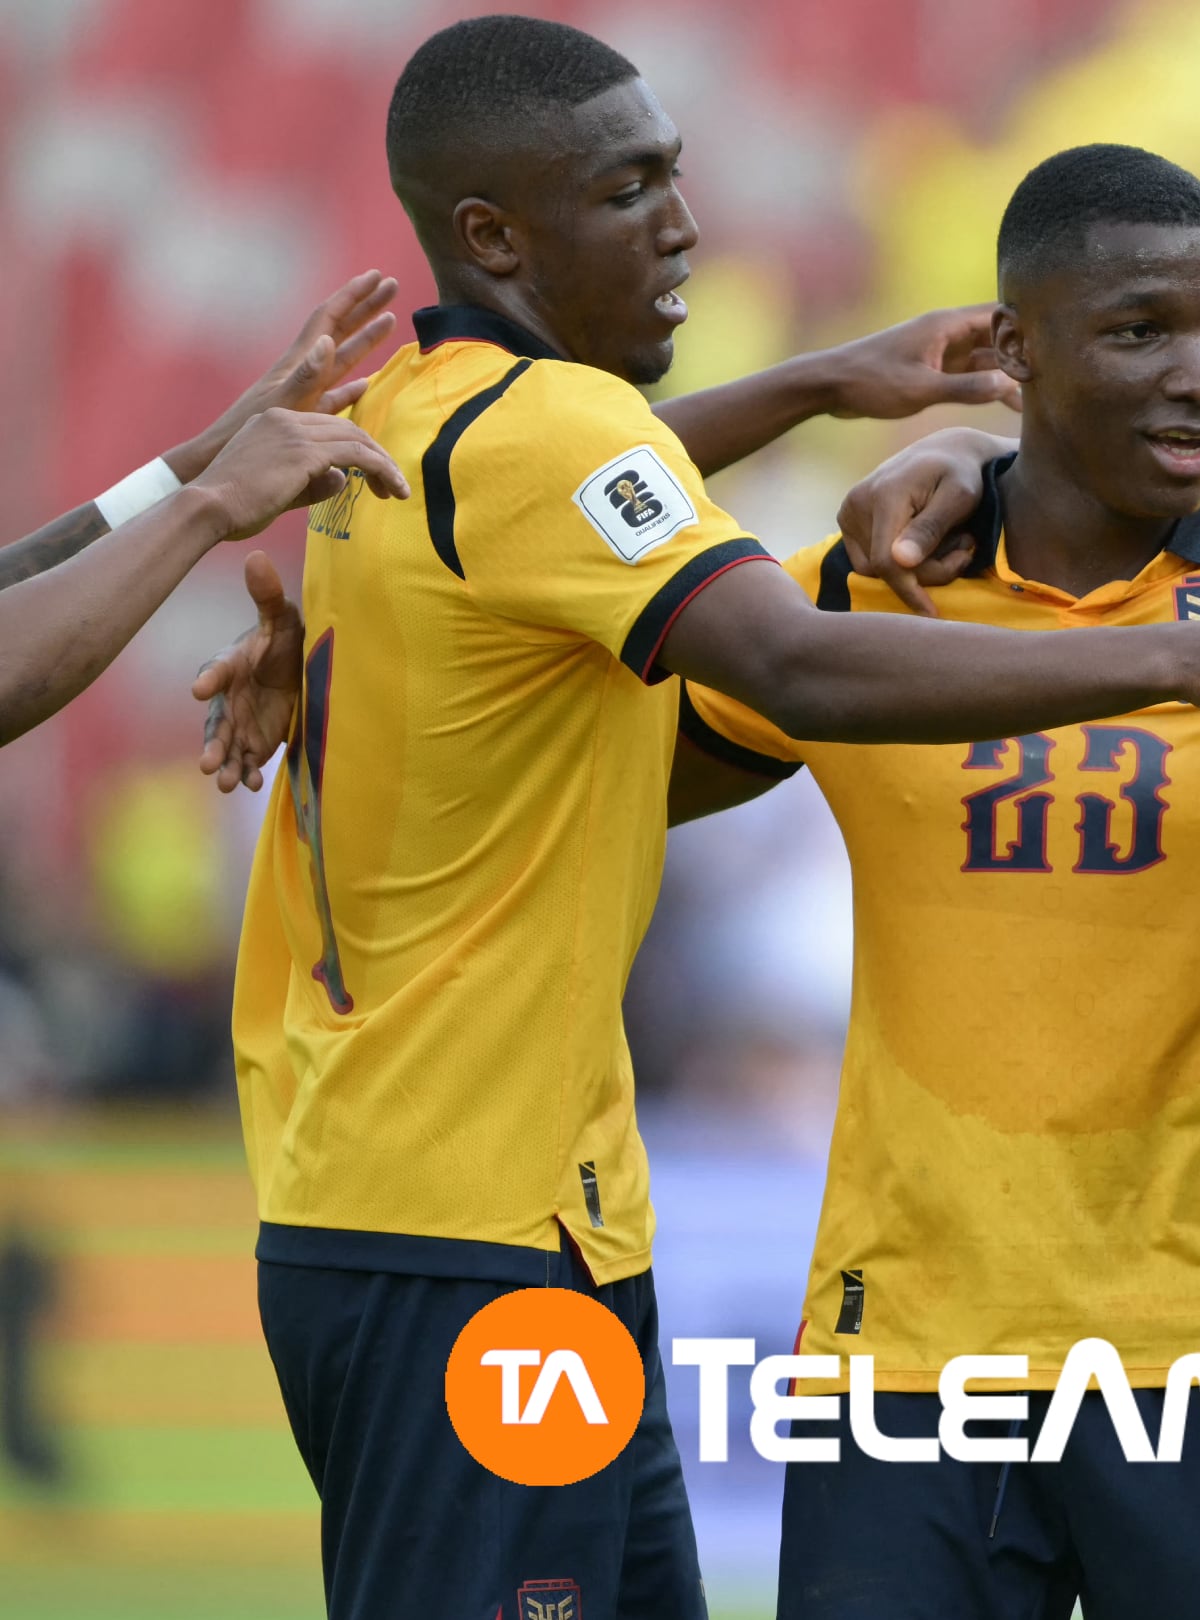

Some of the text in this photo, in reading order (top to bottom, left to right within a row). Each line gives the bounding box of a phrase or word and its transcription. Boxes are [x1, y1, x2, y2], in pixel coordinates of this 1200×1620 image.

[635, 512, 671, 536] QUALIFIERS
[636, 508, 655, 521] FIFA
[960, 724, 1174, 875] 23
